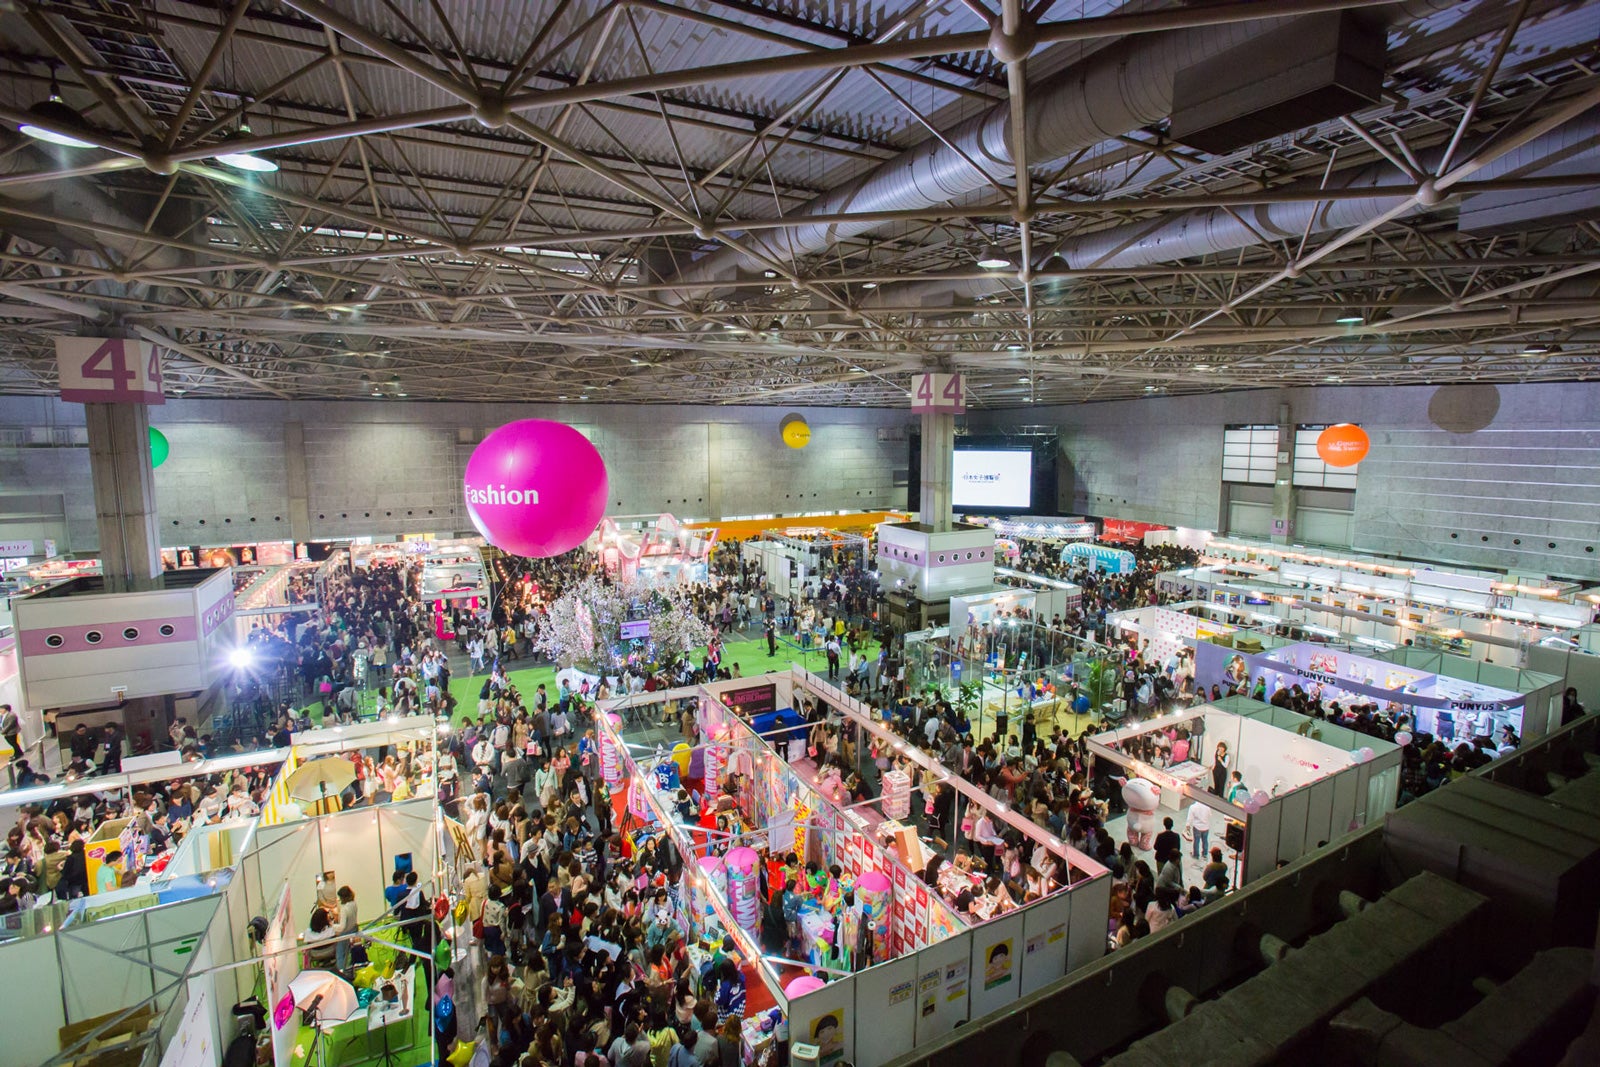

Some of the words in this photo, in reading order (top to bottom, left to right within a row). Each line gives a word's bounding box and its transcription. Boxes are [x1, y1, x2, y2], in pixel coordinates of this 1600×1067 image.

[81, 338, 136, 391] 4
[148, 344, 162, 392] 4
[917, 371, 933, 406] 4
[943, 371, 963, 406] 4
[465, 484, 539, 505] Fashion
[1297, 668, 1336, 685] PUNYUS
[1451, 702, 1494, 711] PUNYUS
